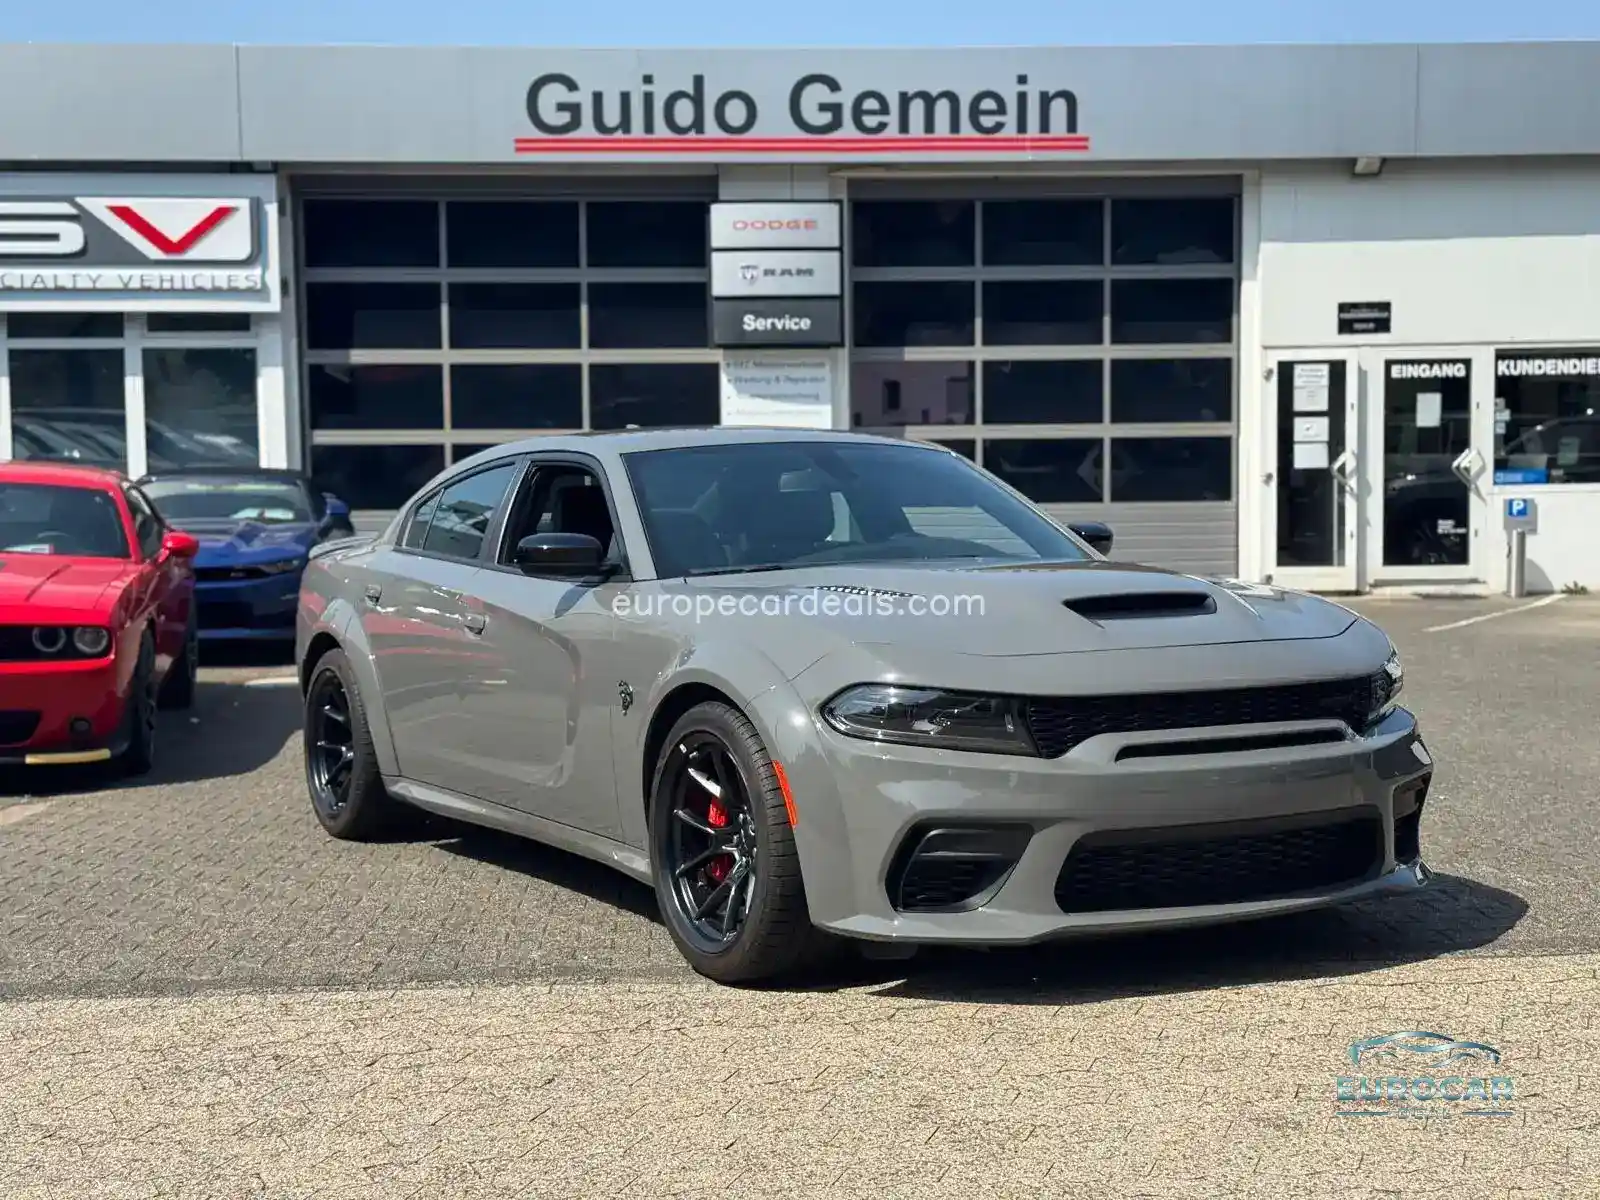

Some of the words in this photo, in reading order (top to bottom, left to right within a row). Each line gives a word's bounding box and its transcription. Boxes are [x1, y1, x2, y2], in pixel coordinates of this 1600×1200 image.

[525, 72, 758, 136] Guido
[788, 72, 1079, 136] Gemein
[732, 219, 817, 231] DODGE
[763, 267, 815, 278] RAM
[0, 273, 103, 290] CIALTY
[117, 273, 259, 290] VEHICLES
[742, 314, 812, 331] Service
[1390, 363, 1467, 379] EINGANG
[1497, 358, 1600, 377] KUNDENDIE
[1511, 500, 1525, 515] P
